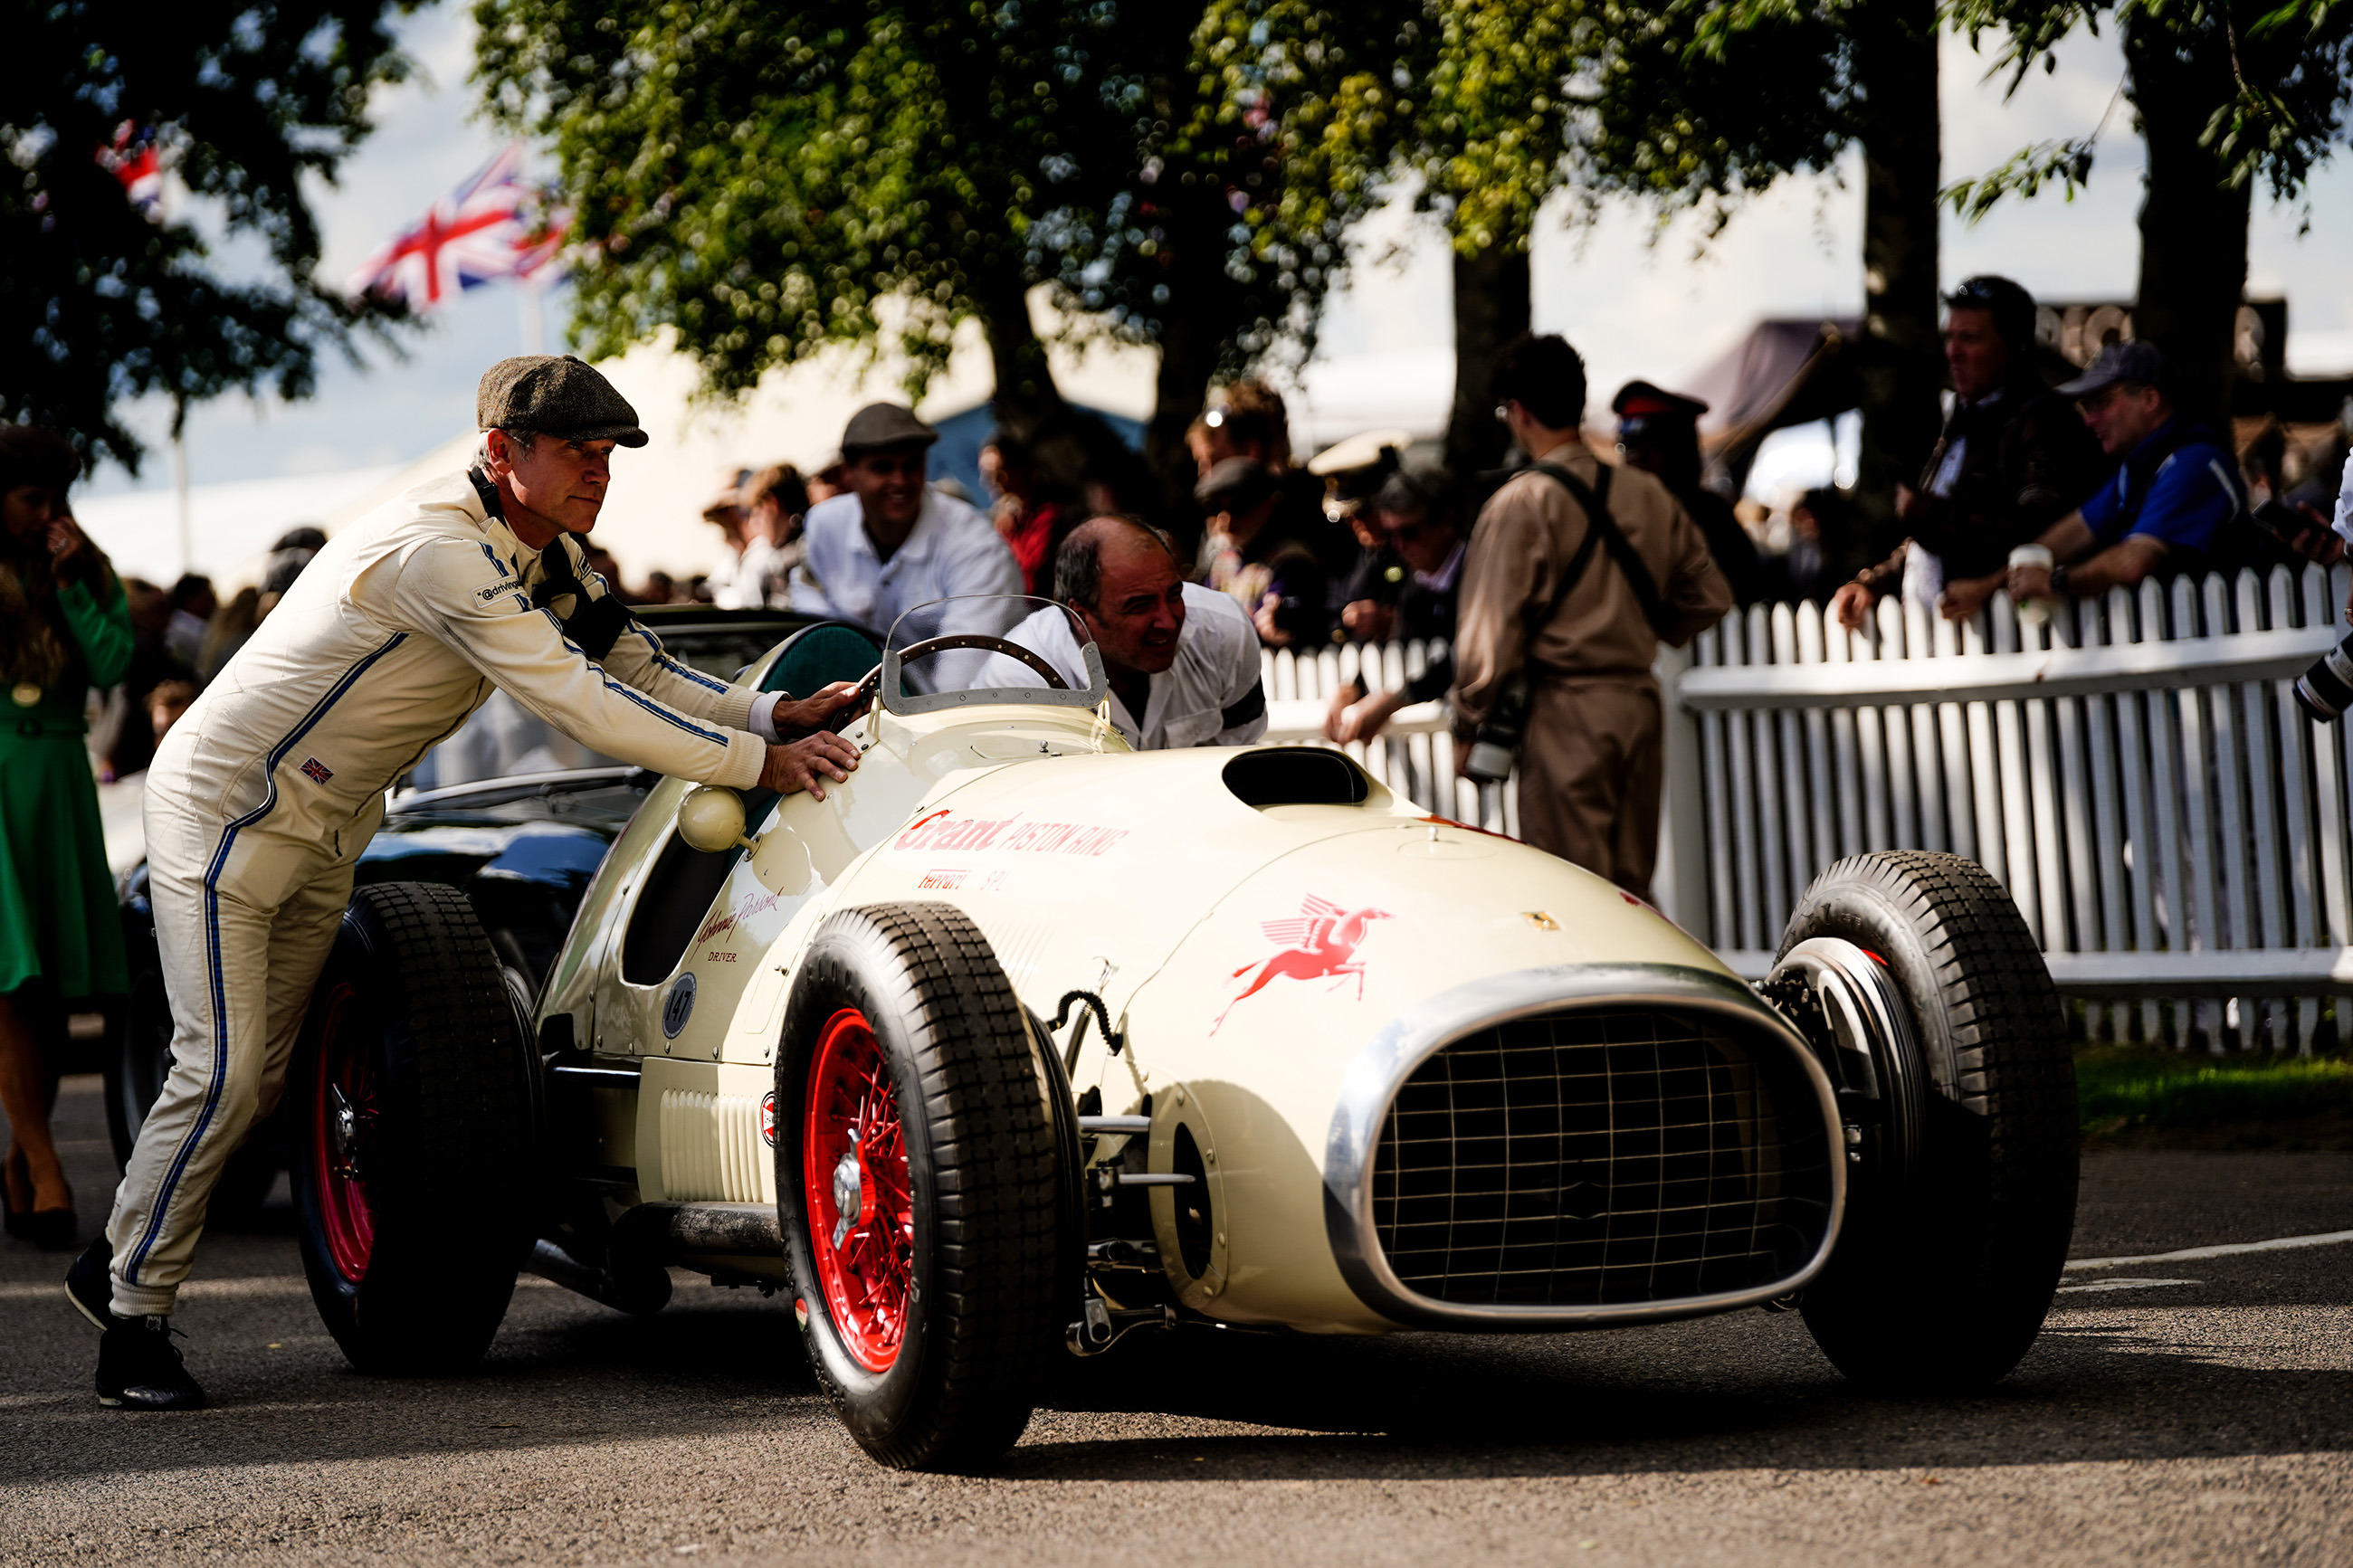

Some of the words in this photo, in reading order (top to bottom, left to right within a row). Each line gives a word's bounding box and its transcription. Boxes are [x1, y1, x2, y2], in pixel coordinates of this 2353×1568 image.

[894, 809, 1024, 851] Grant
[997, 822, 1085, 853] PISTON
[918, 869, 971, 889] Ferrari
[708, 951, 737, 963] DRIVER
[666, 989, 691, 1023] 147
